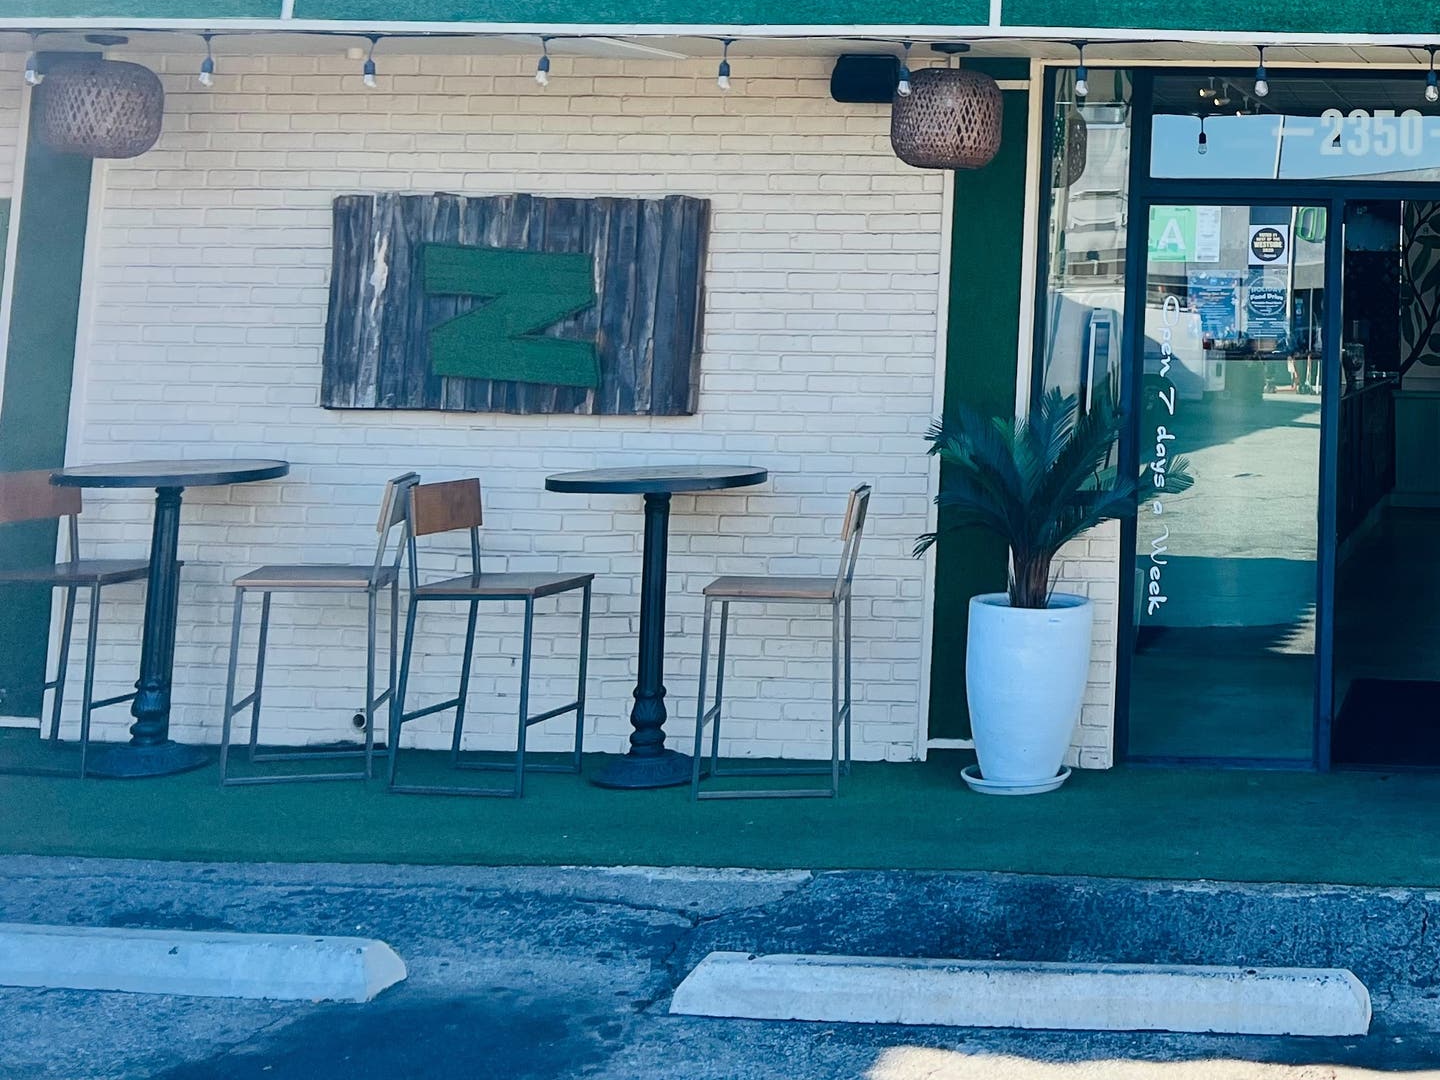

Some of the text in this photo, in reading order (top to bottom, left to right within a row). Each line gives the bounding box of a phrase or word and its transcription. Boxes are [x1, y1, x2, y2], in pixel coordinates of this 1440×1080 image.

[1319, 108, 1424, 157] 2350
[1158, 218, 1187, 250] A
[422, 242, 600, 390] Z
[1150, 425, 1176, 488] days
[1147, 524, 1170, 616] Week
